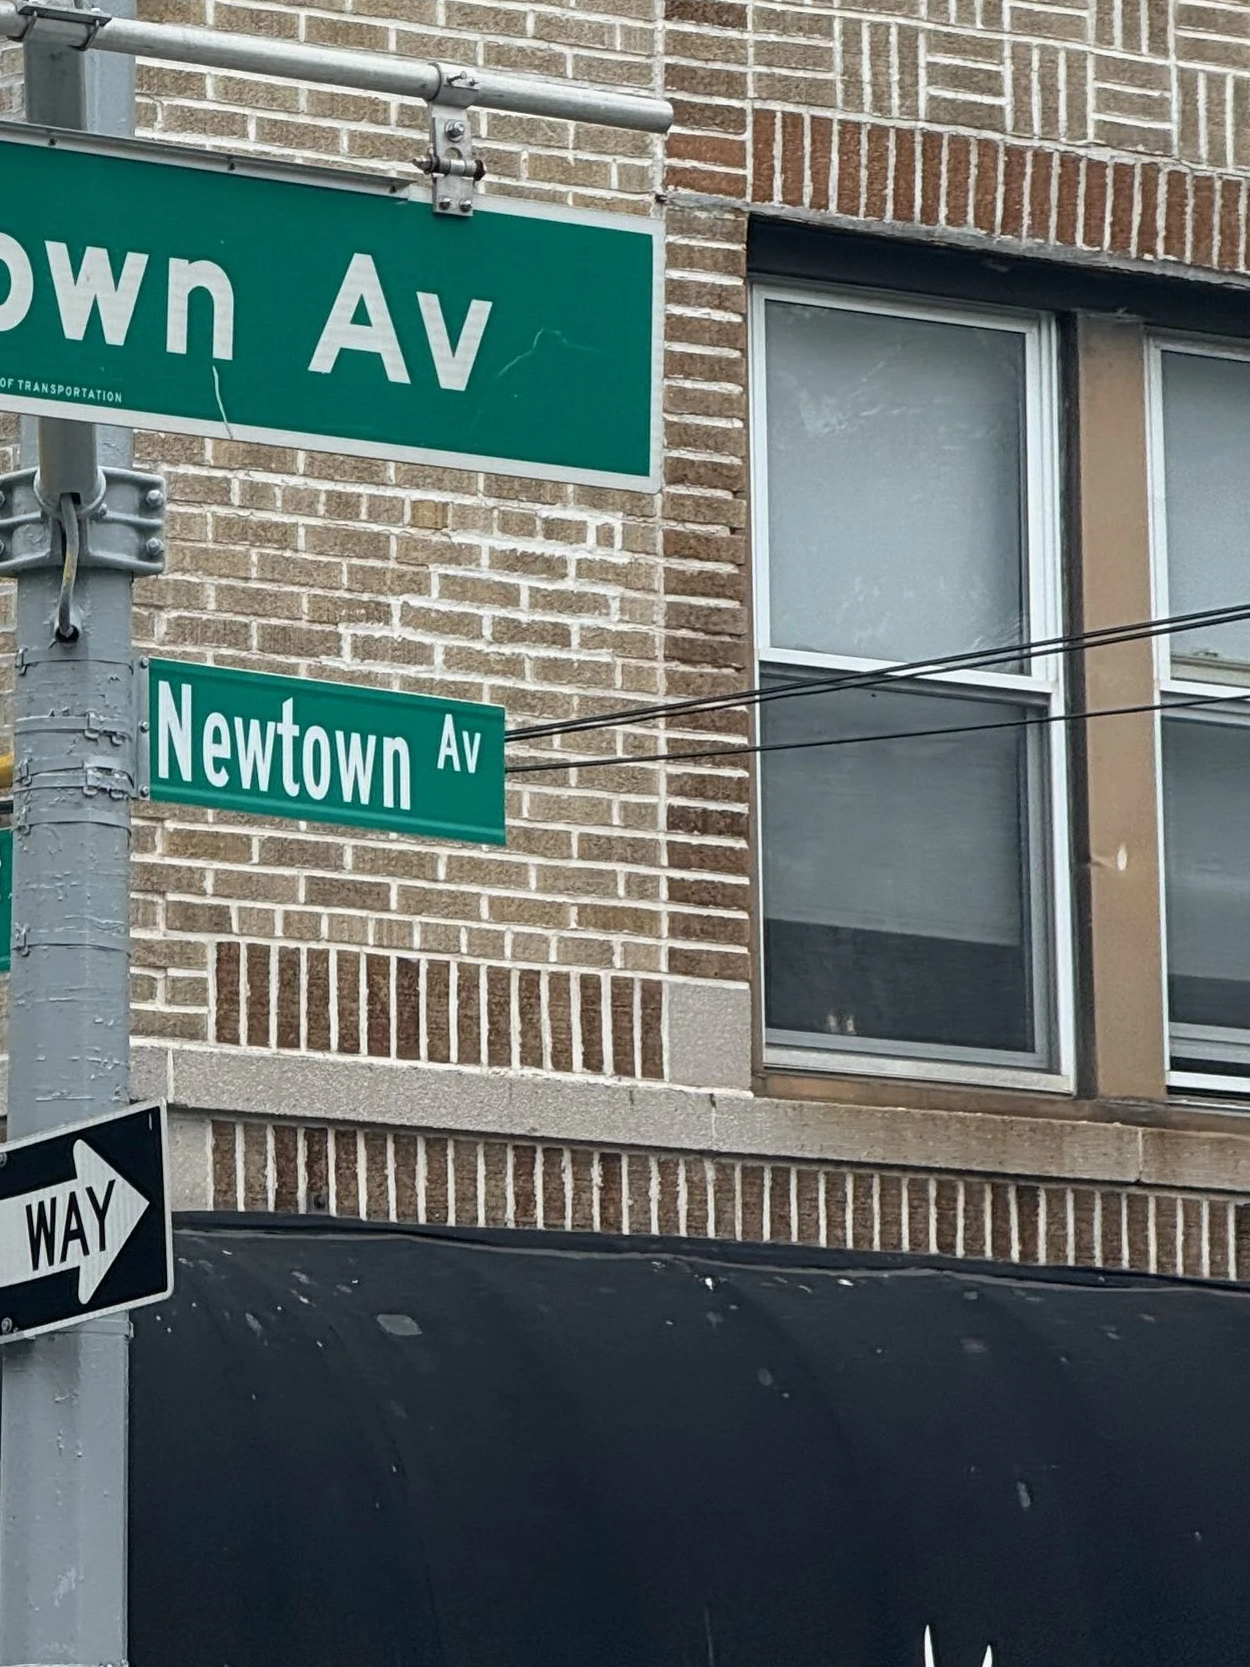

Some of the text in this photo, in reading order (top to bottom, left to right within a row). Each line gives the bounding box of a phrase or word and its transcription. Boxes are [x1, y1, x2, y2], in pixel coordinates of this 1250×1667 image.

[308, 253, 493, 392] Av
[0, 377, 14, 389] OF
[18, 379, 122, 403] TRANSPORTATION
[158, 680, 480, 811] Newtown Av
[25, 1179, 116, 1271] WAY
